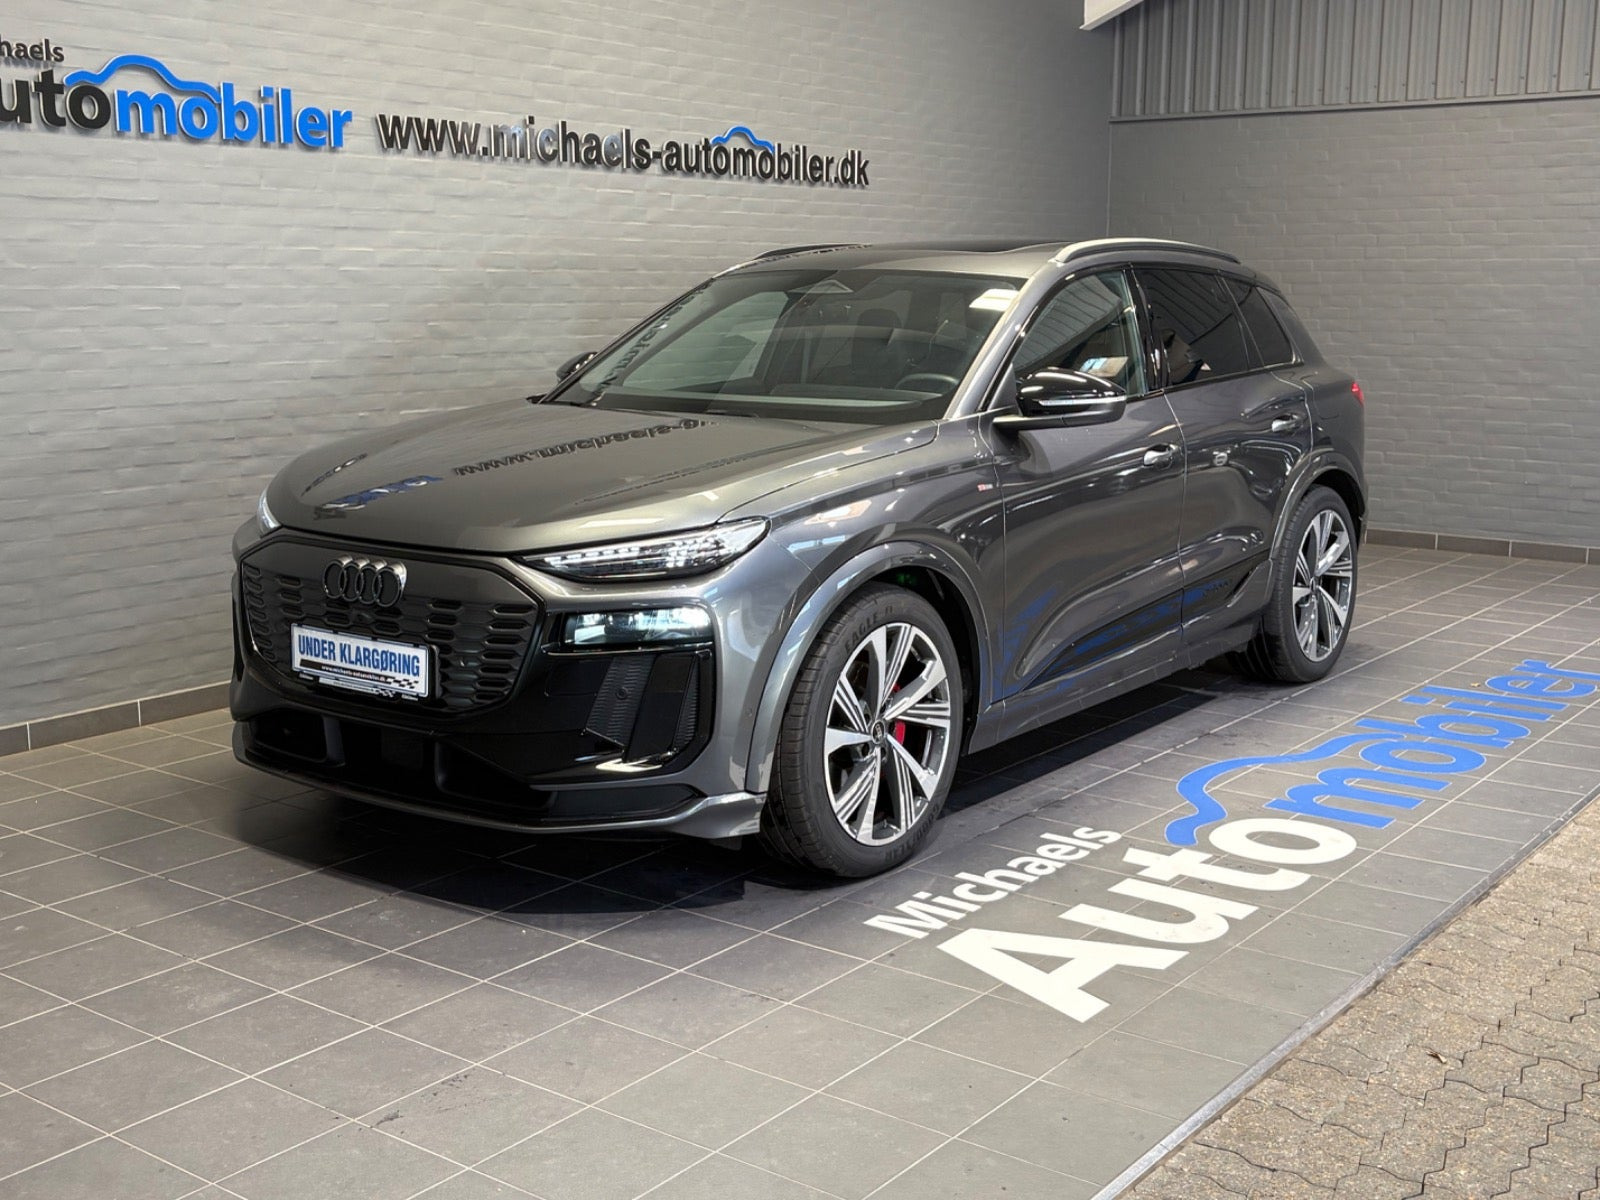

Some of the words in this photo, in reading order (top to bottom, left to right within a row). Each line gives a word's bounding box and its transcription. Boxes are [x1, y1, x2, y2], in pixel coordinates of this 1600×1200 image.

[375, 113, 869, 186] www.michaels-automobiler.dk
[298, 634, 336, 662] UNDER
[340, 642, 420, 677] KLARGØRING
[863, 826, 1122, 939] Michaels
[936, 659, 1600, 1023] Automobiler
